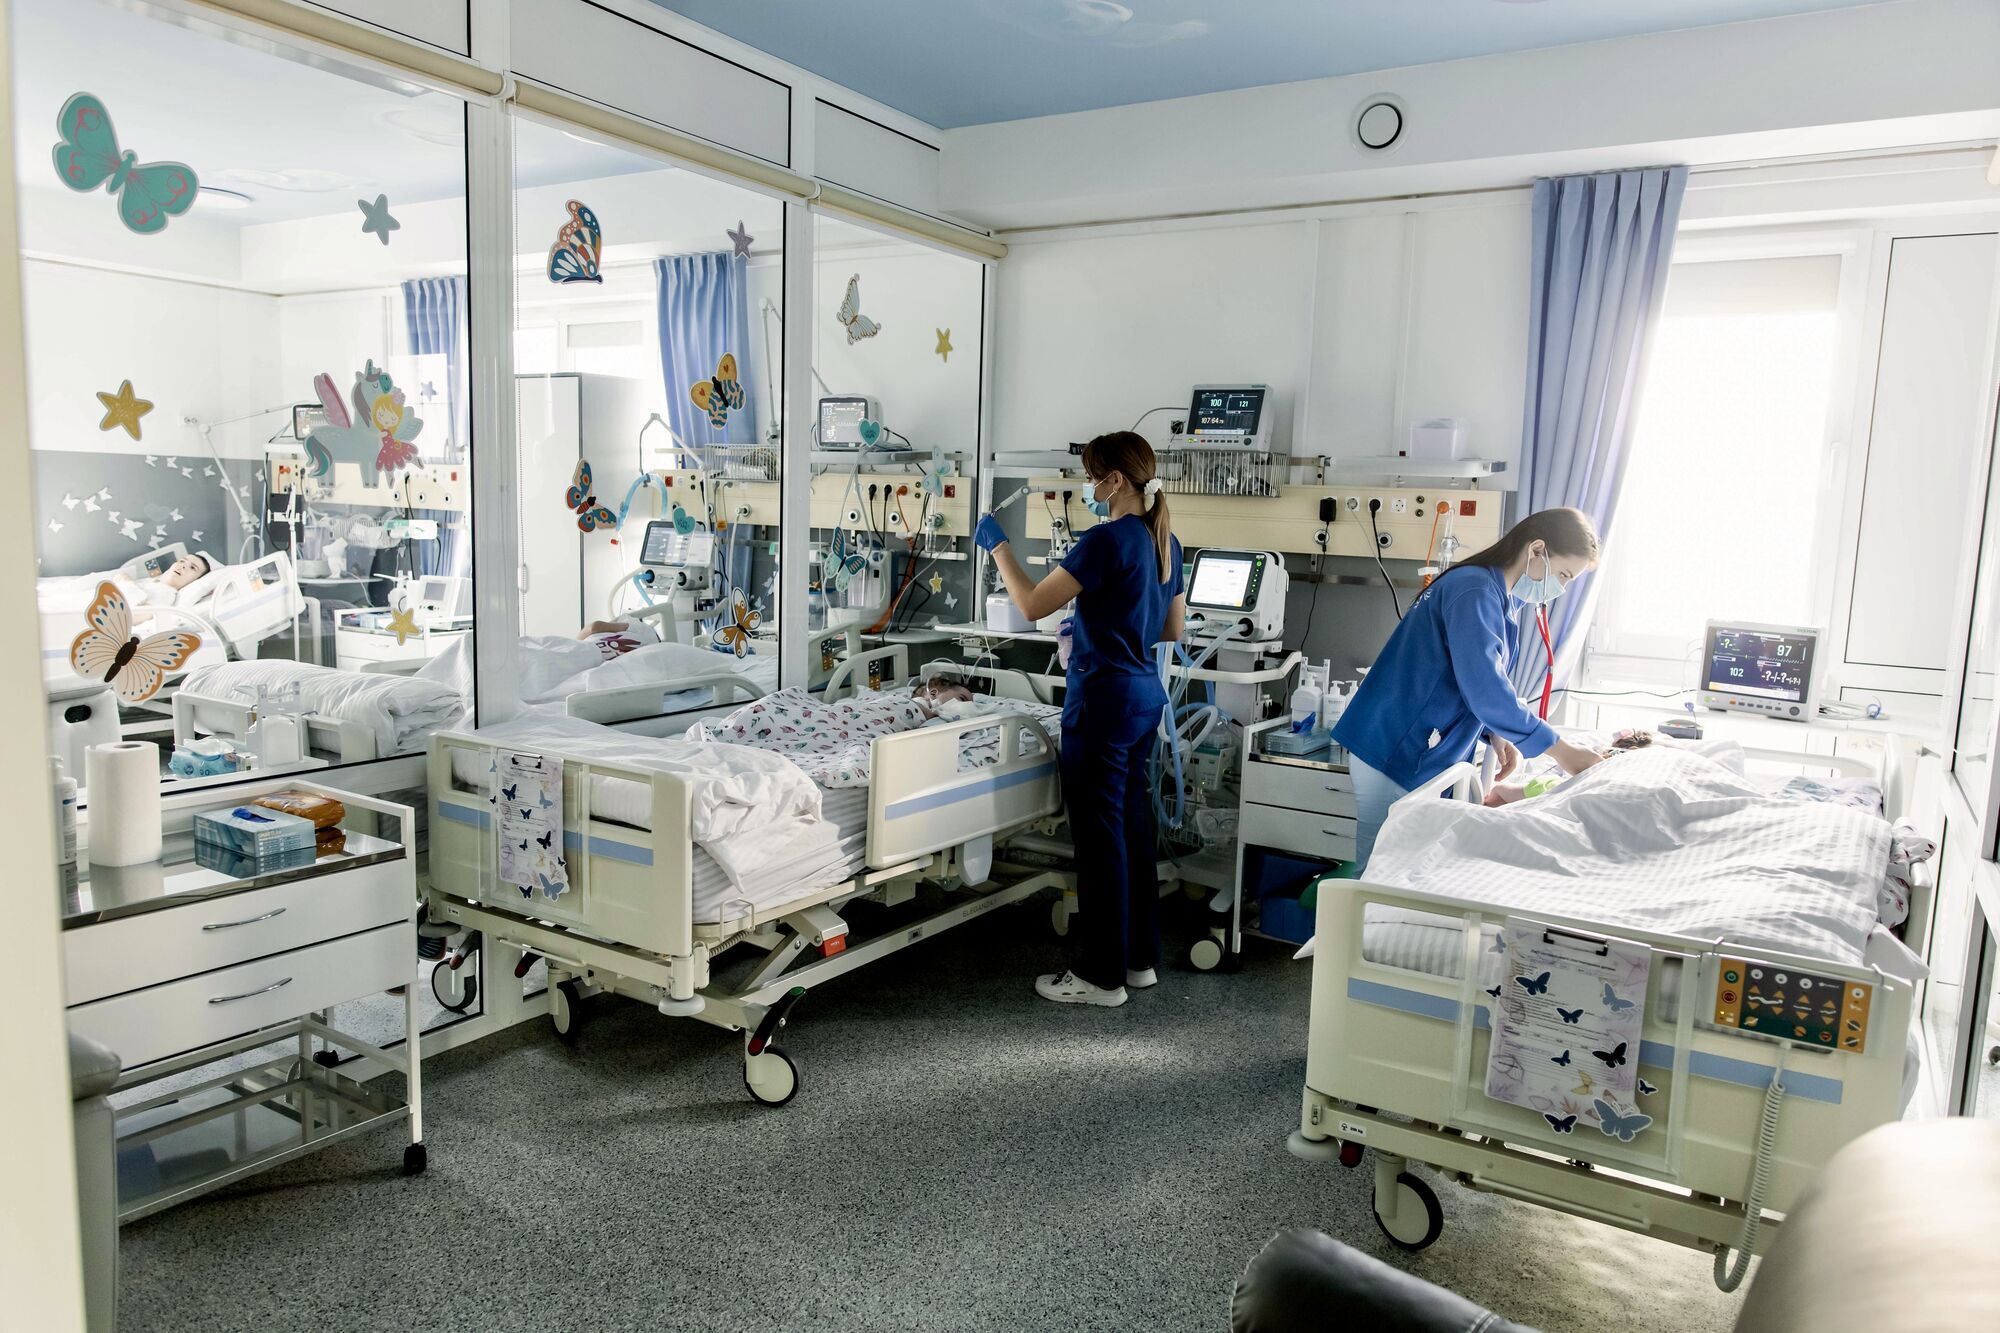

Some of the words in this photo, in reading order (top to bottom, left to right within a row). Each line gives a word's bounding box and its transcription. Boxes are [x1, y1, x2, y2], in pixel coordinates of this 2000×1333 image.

[1210, 398, 1222, 407] 100
[1239, 400, 1249, 408] 121
[1777, 644, 1792, 657] 97
[1729, 667, 1744, 678] 102
